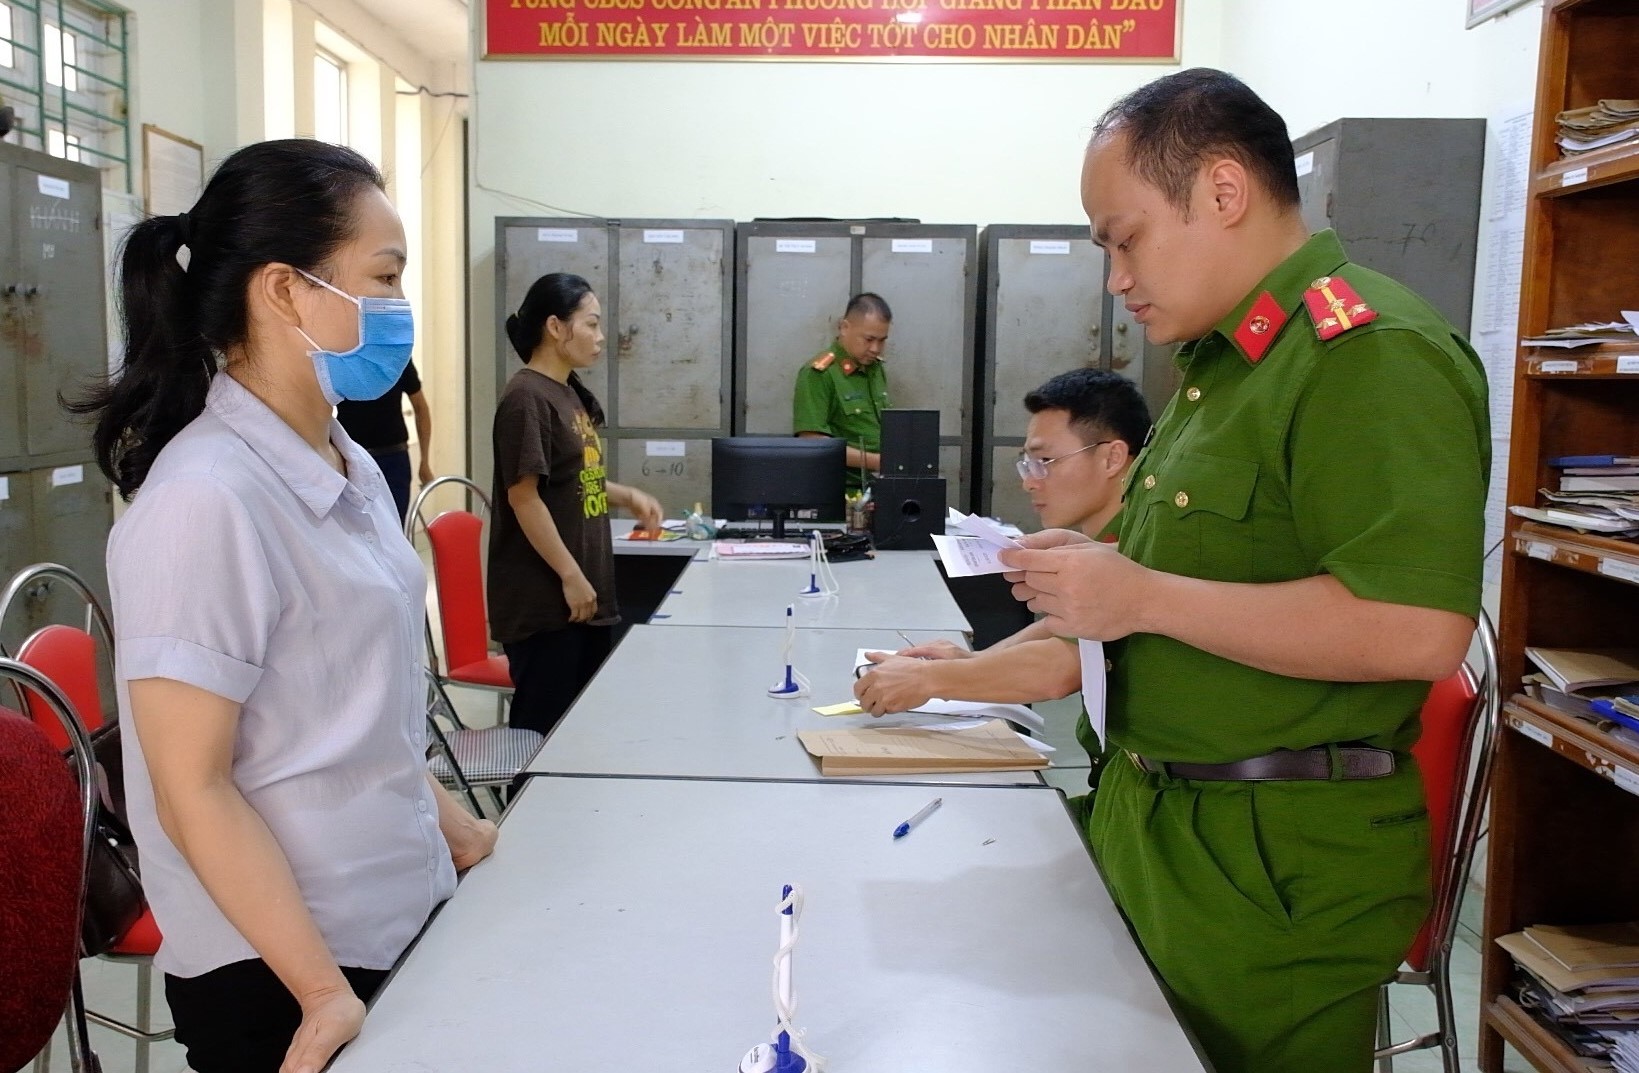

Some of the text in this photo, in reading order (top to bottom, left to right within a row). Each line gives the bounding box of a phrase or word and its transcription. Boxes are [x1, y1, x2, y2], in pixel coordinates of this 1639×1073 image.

[539, 12, 589, 47] MỖI
[596, 16, 669, 47] NGÀY
[676, 16, 733, 47] LÀM
[739, 16, 795, 53] MỘT
[801, 17, 861, 53] VIỆC
[923, 23, 977, 49] CHO
[983, 18, 1060, 49] NHÂN
